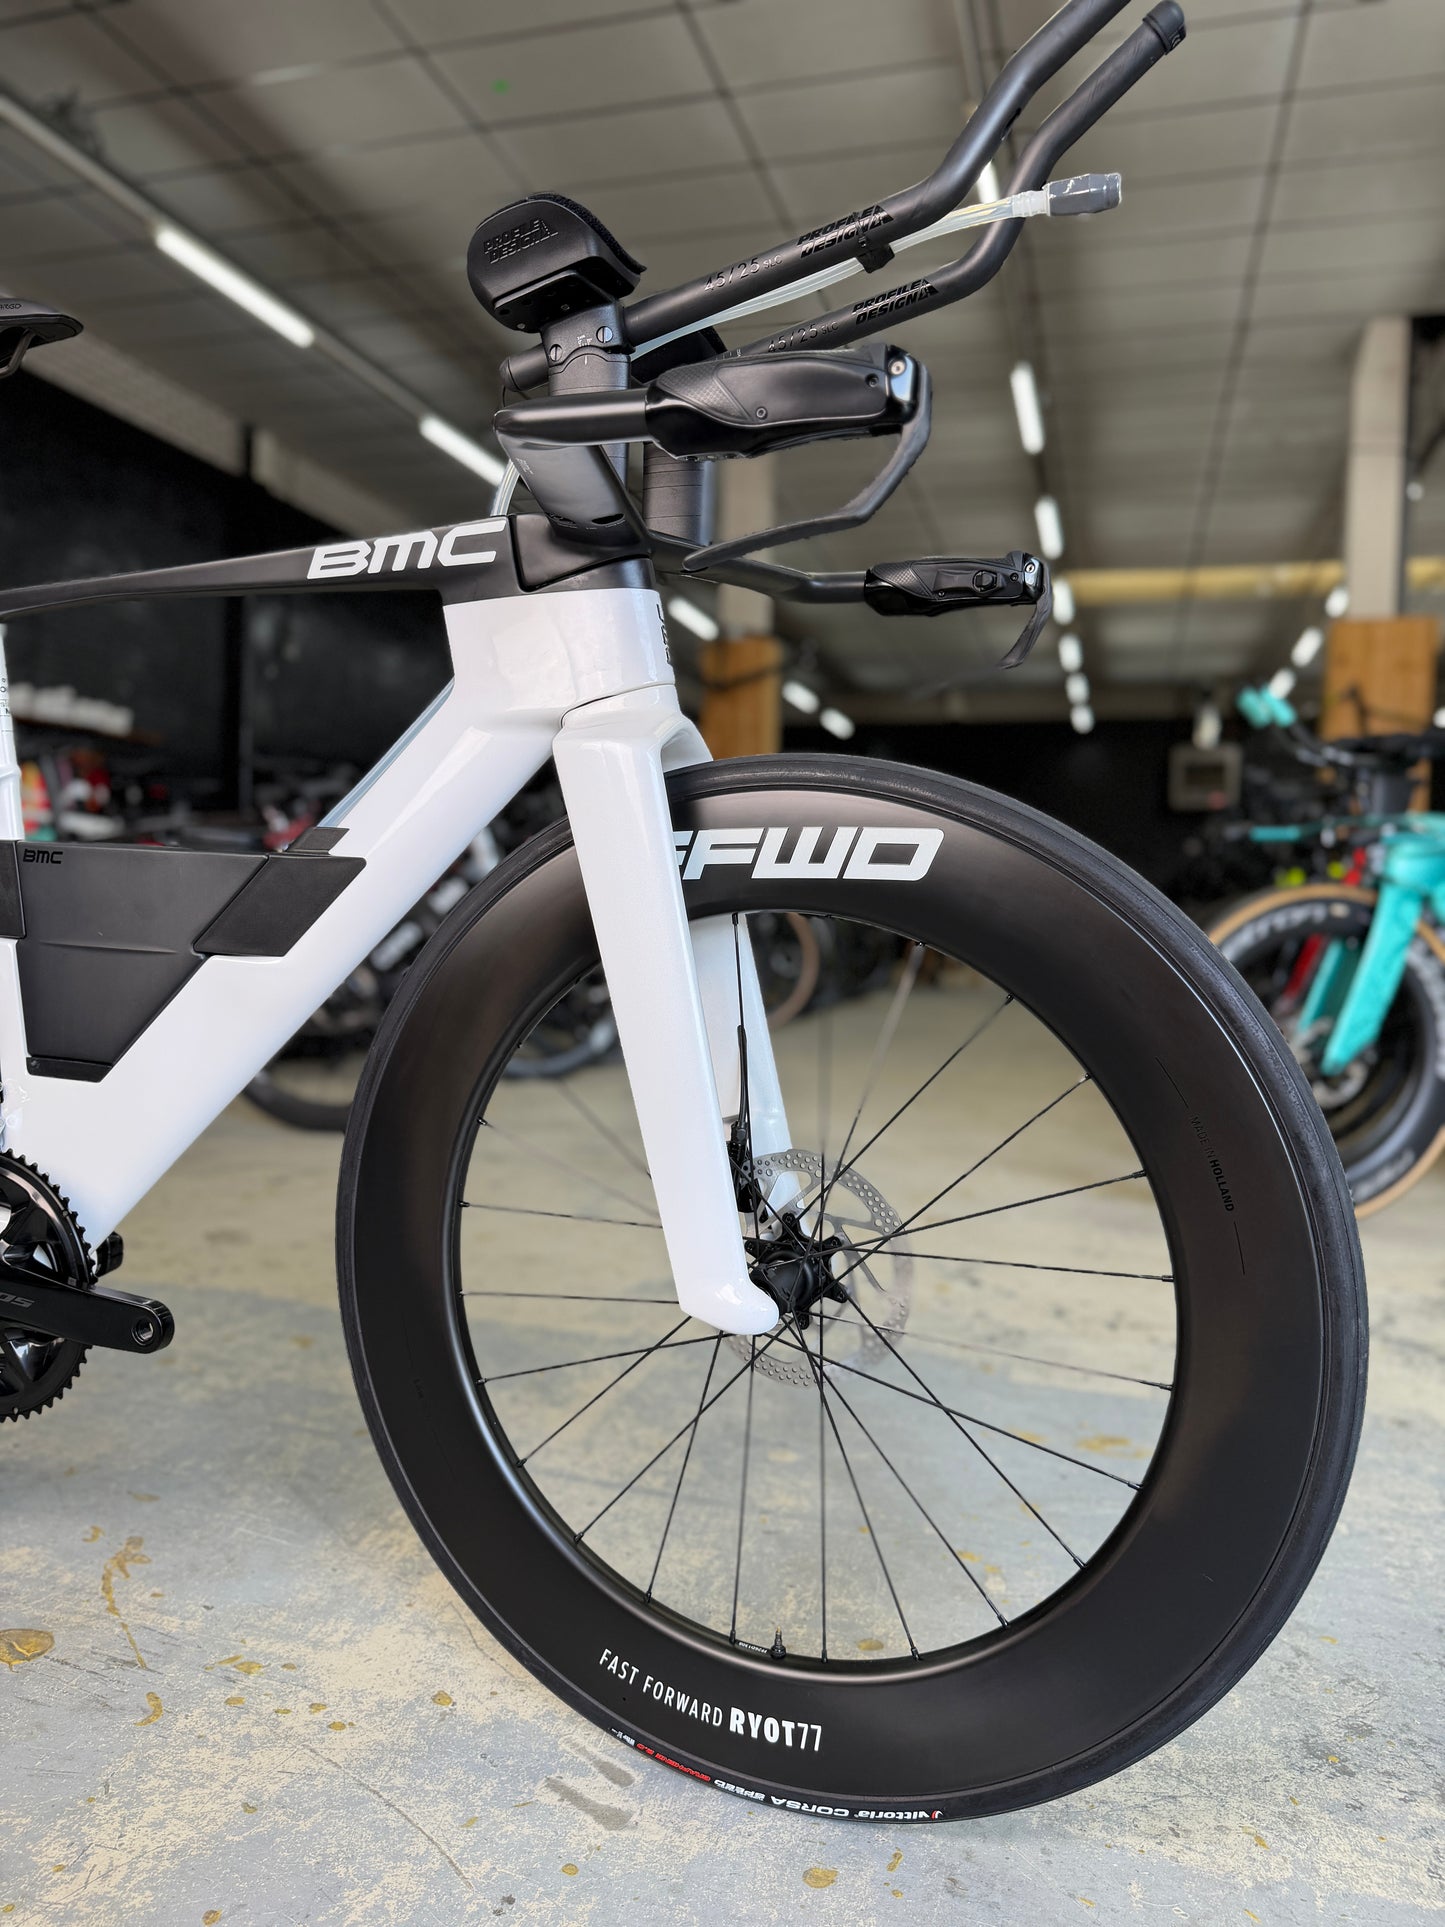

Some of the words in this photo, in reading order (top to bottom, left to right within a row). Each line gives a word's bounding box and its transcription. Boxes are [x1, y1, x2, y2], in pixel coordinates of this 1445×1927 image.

[483, 218, 541, 255] PROFILE
[490, 235, 541, 265] DESIGN
[704, 256, 761, 291] 45/25
[763, 254, 783, 269] SLC
[852, 280, 924, 313] PROFILE
[855, 292, 923, 326] DESIGN
[821, 321, 839, 335] SLC
[306, 519, 507, 580] BMC
[22, 848, 64, 865] BMC
[1190, 1115, 1210, 1146] MADE
[1209, 1159, 1235, 1212] HOLLAND
[599, 1648, 640, 1686] FAST
[642, 1675, 723, 1727] FORWARD
[729, 1706, 823, 1753] RYOT77
[714, 1779, 766, 1801] SPEED
[770, 1796, 850, 1818] CORSA
